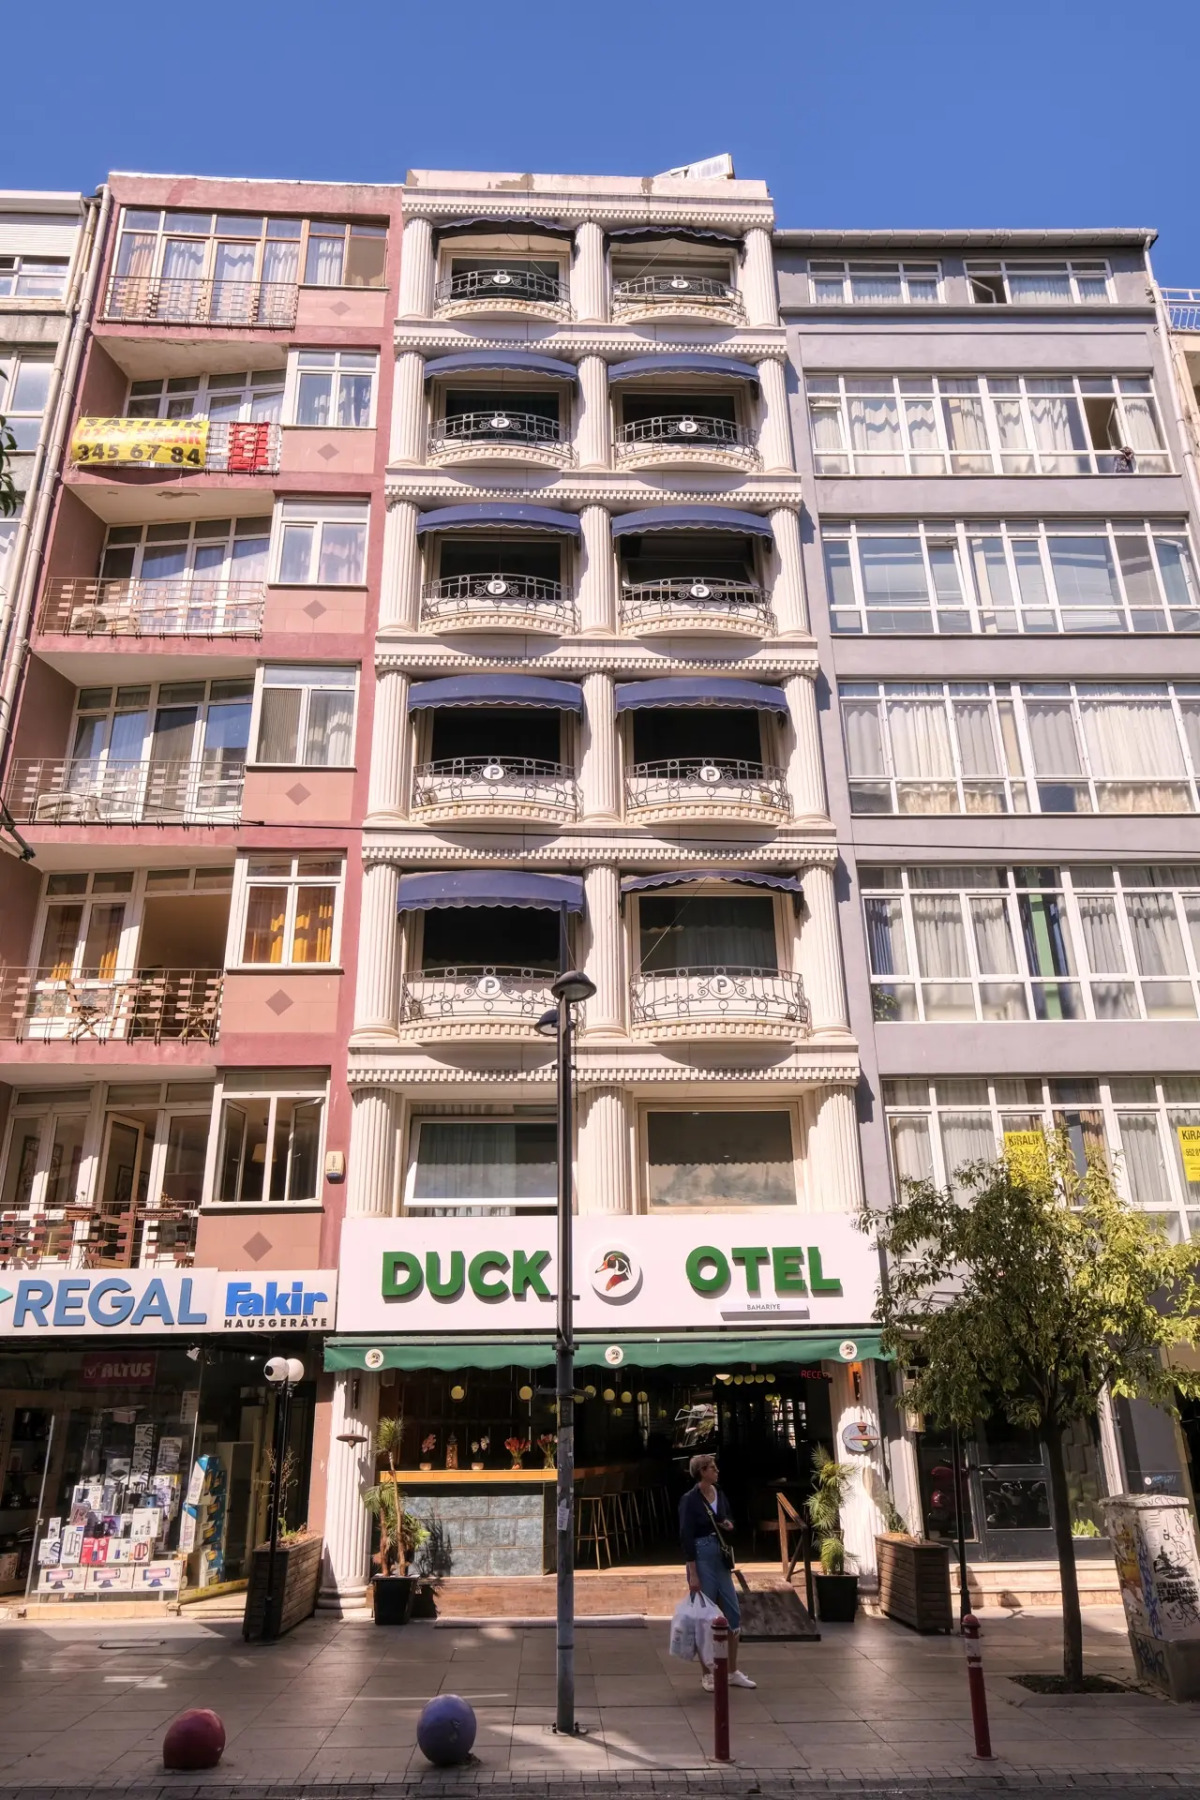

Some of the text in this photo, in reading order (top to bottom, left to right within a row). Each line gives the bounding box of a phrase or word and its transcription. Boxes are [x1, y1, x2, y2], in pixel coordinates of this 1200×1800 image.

[77, 443, 201, 465] 345 67 84
[382, 1245, 842, 1300] DUCK OTEL
[13, 1278, 207, 1327] REGAL
[224, 1281, 328, 1317] Fakir
[223, 1317, 328, 1328] HAUSGERÄTE
[101, 1362, 152, 1379] ALTUS
